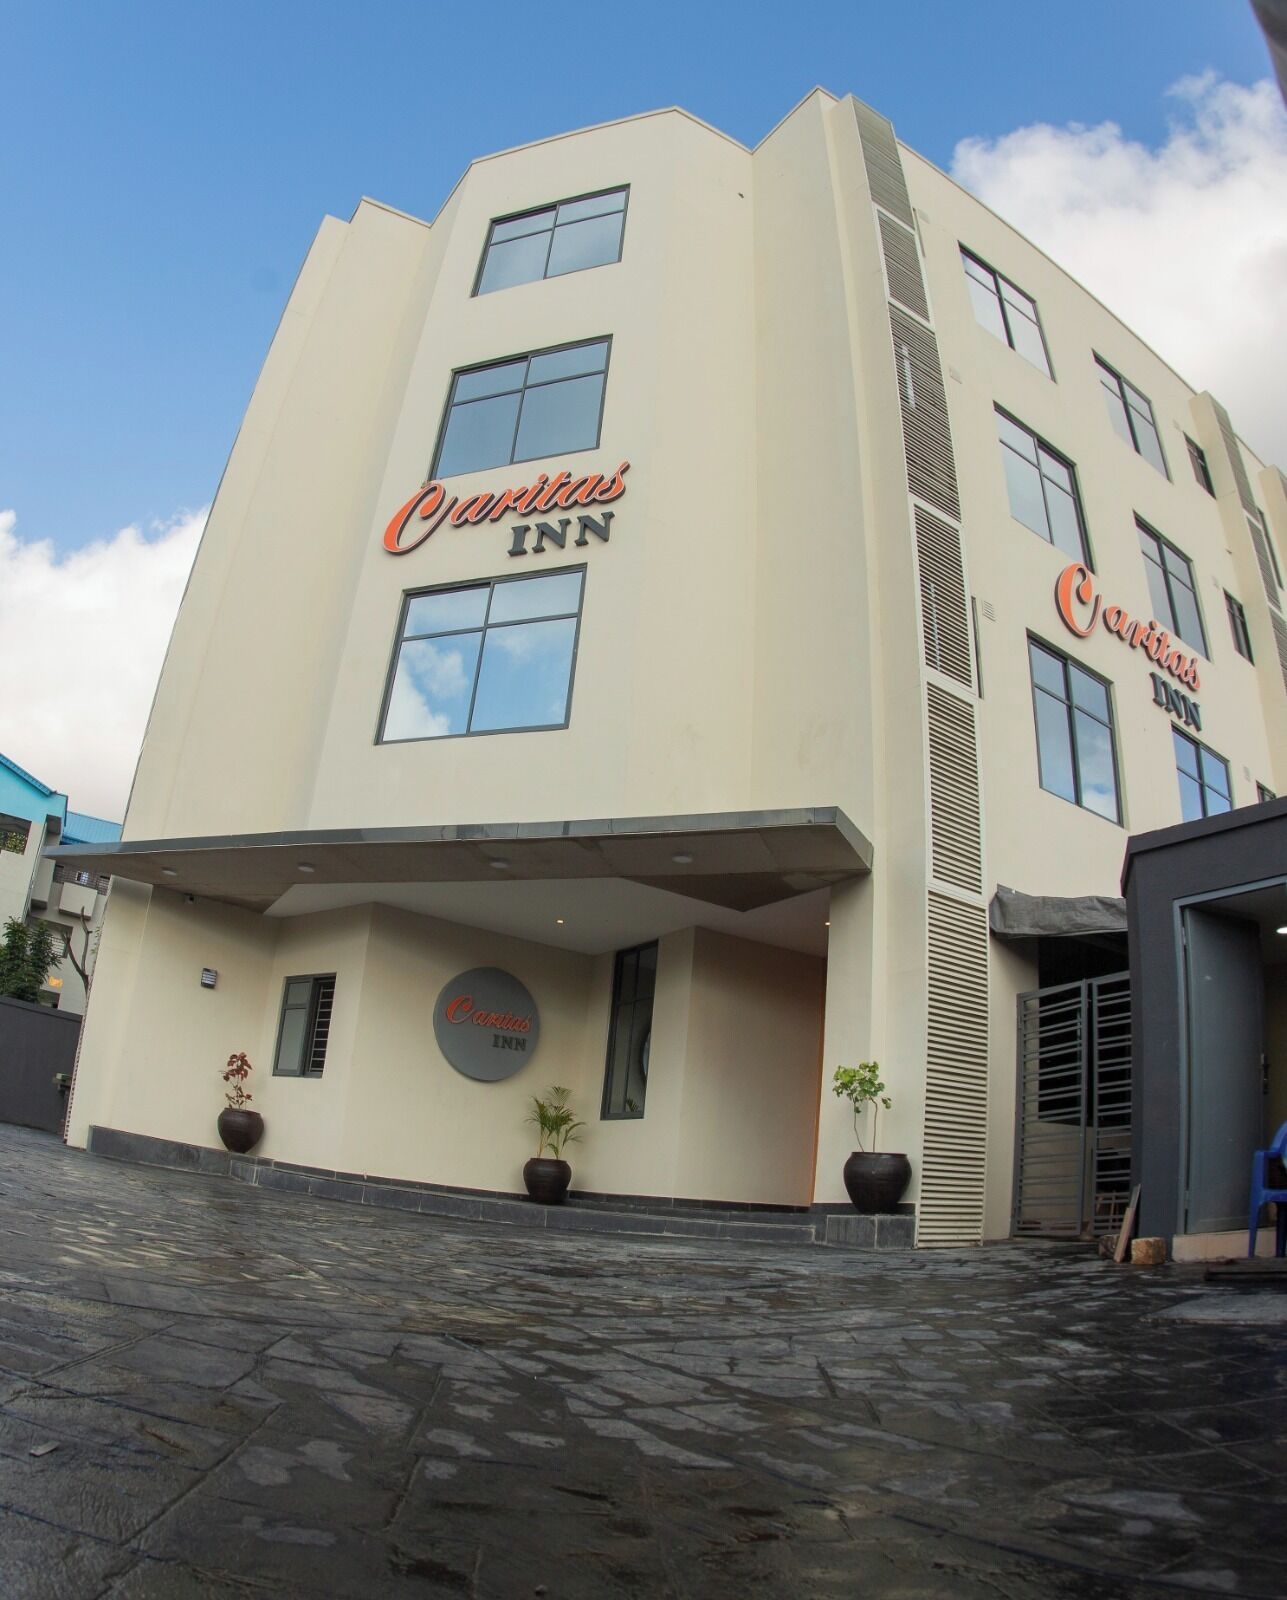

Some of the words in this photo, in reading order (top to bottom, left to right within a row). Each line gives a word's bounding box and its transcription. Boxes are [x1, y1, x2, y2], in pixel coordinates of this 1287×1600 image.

[382, 460, 631, 555] Caritas
[507, 511, 615, 556] INN
[1054, 563, 1201, 691] Caritas
[1149, 672, 1202, 732] INN
[446, 994, 532, 1034] Caritas
[492, 1034, 527, 1051] INN
